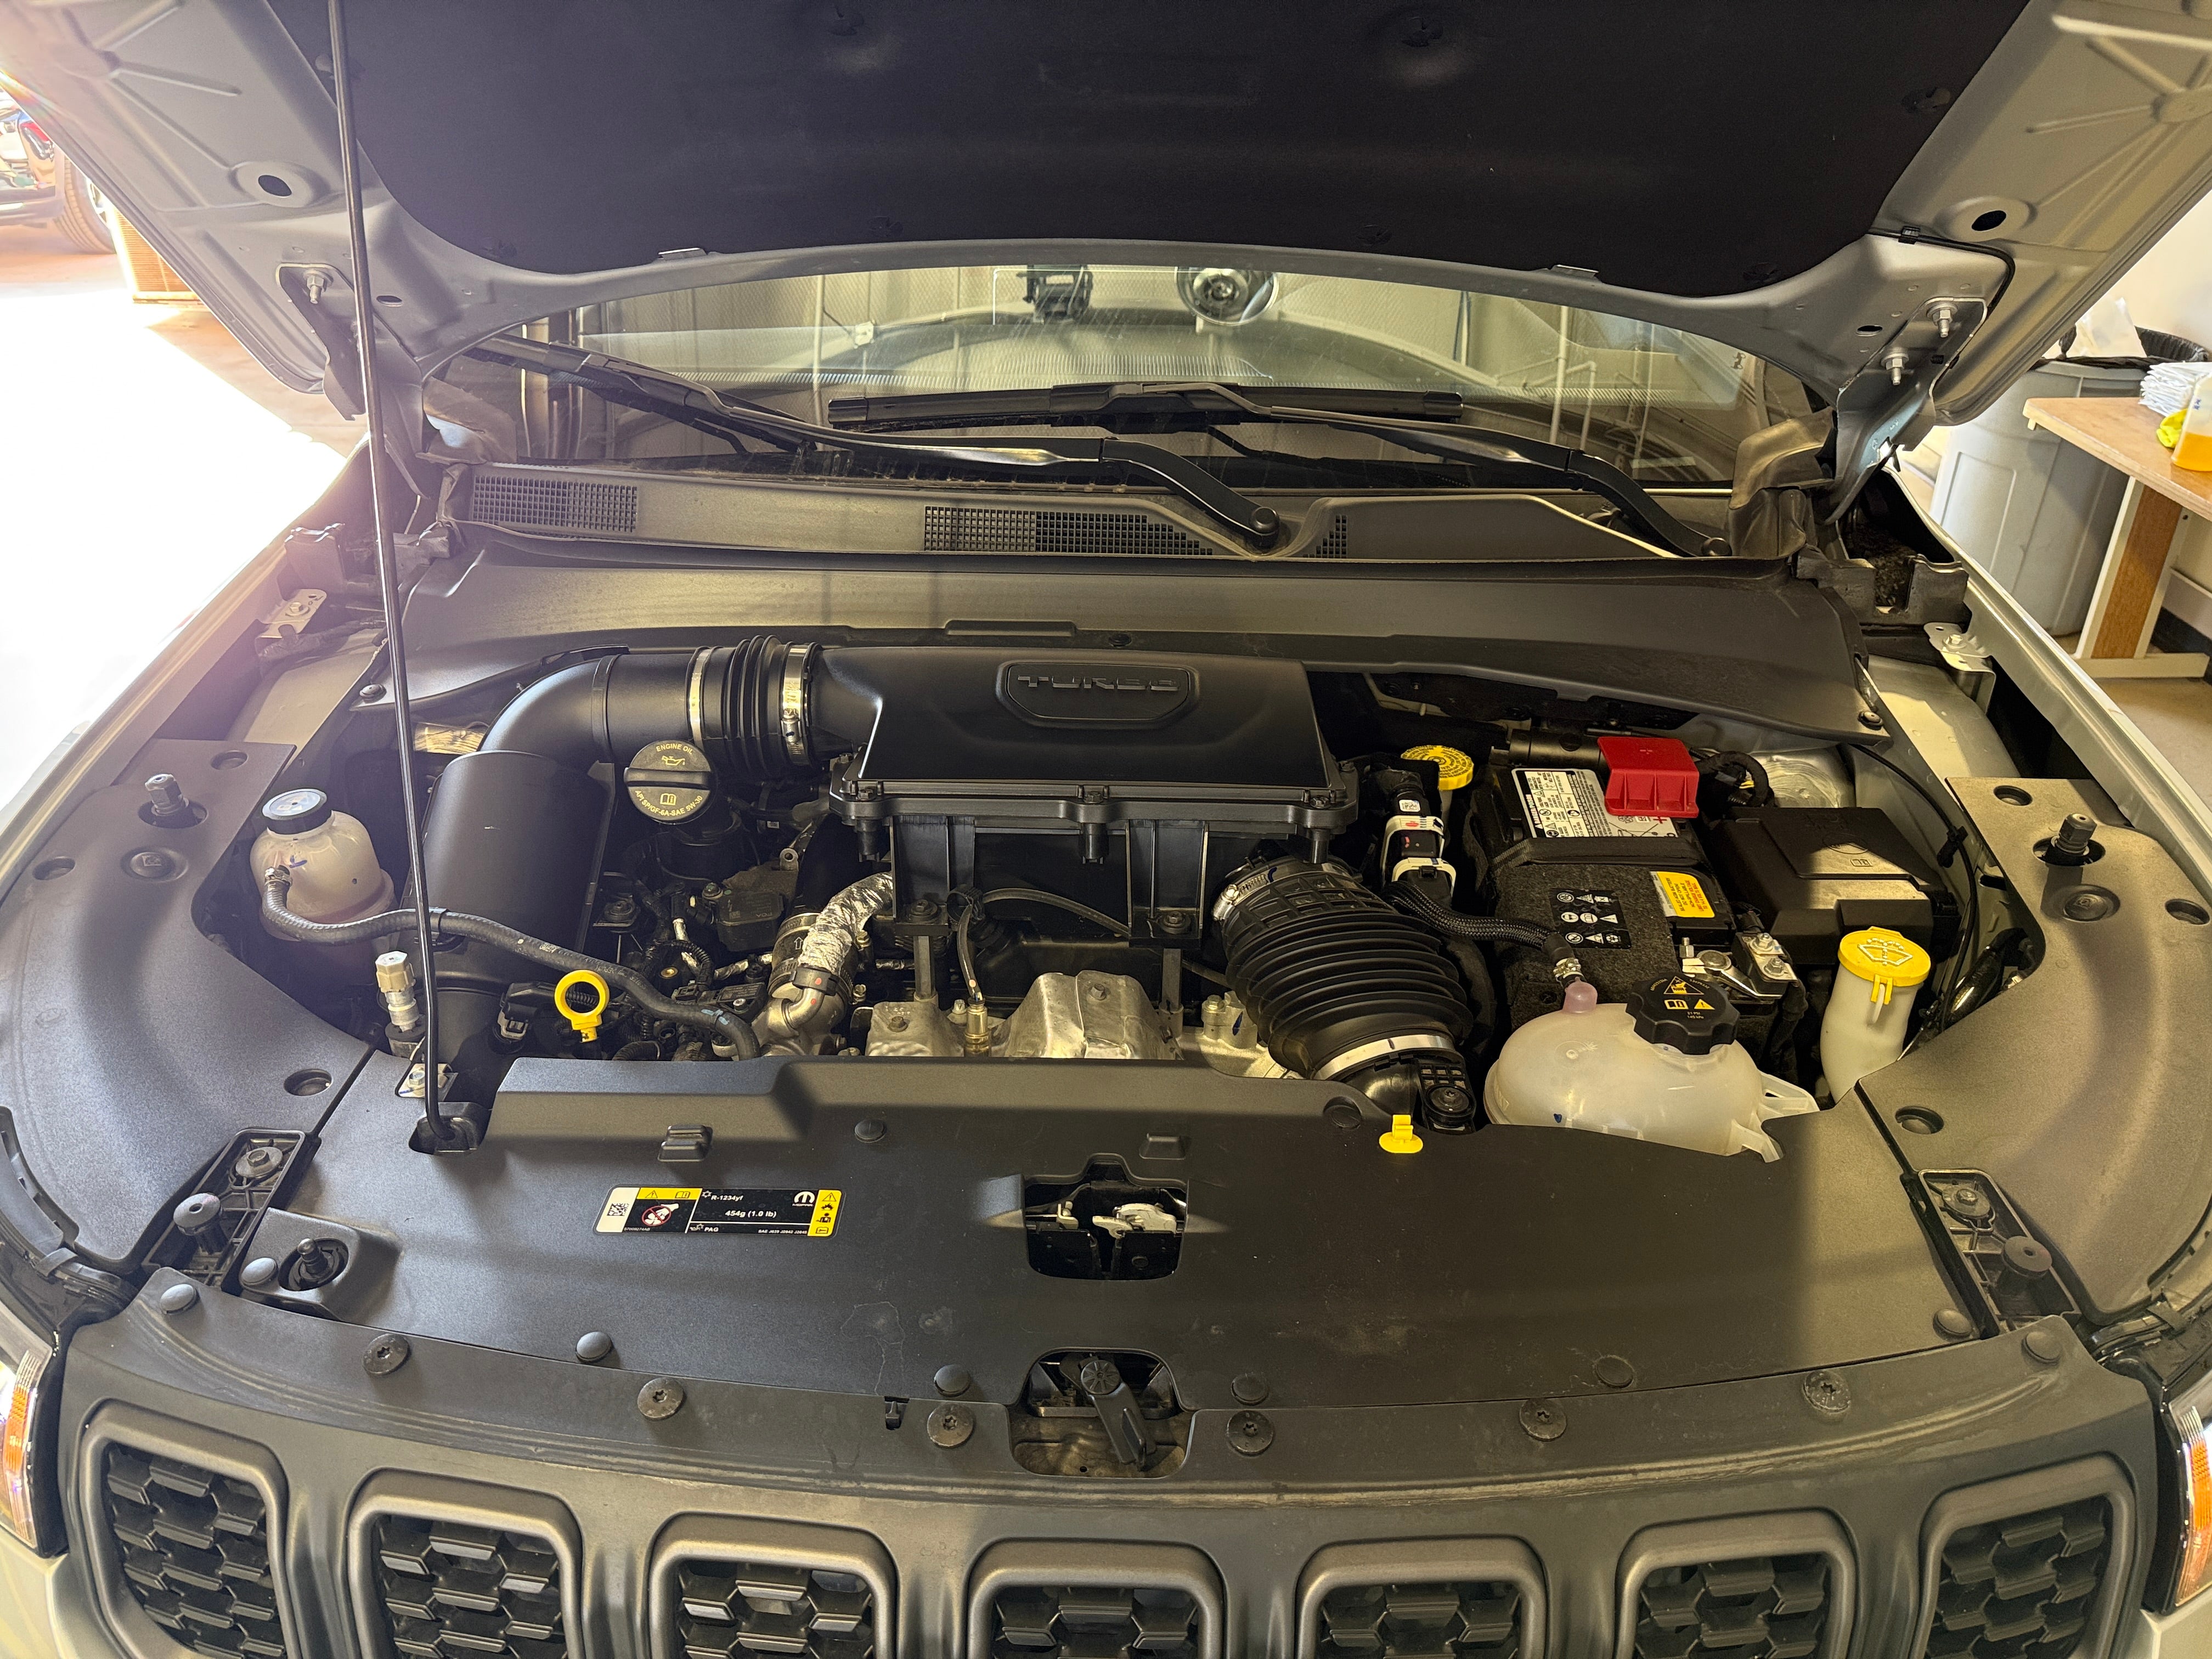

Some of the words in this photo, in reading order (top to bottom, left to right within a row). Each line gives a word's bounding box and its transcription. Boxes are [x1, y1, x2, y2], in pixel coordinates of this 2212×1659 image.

[1017, 675, 1180, 691] TURBO
[656, 743, 682, 752] ENGINE
[682, 746, 693, 755] OIL
[635, 790, 643, 802] API
[685, 795, 703, 812] 5W-30
